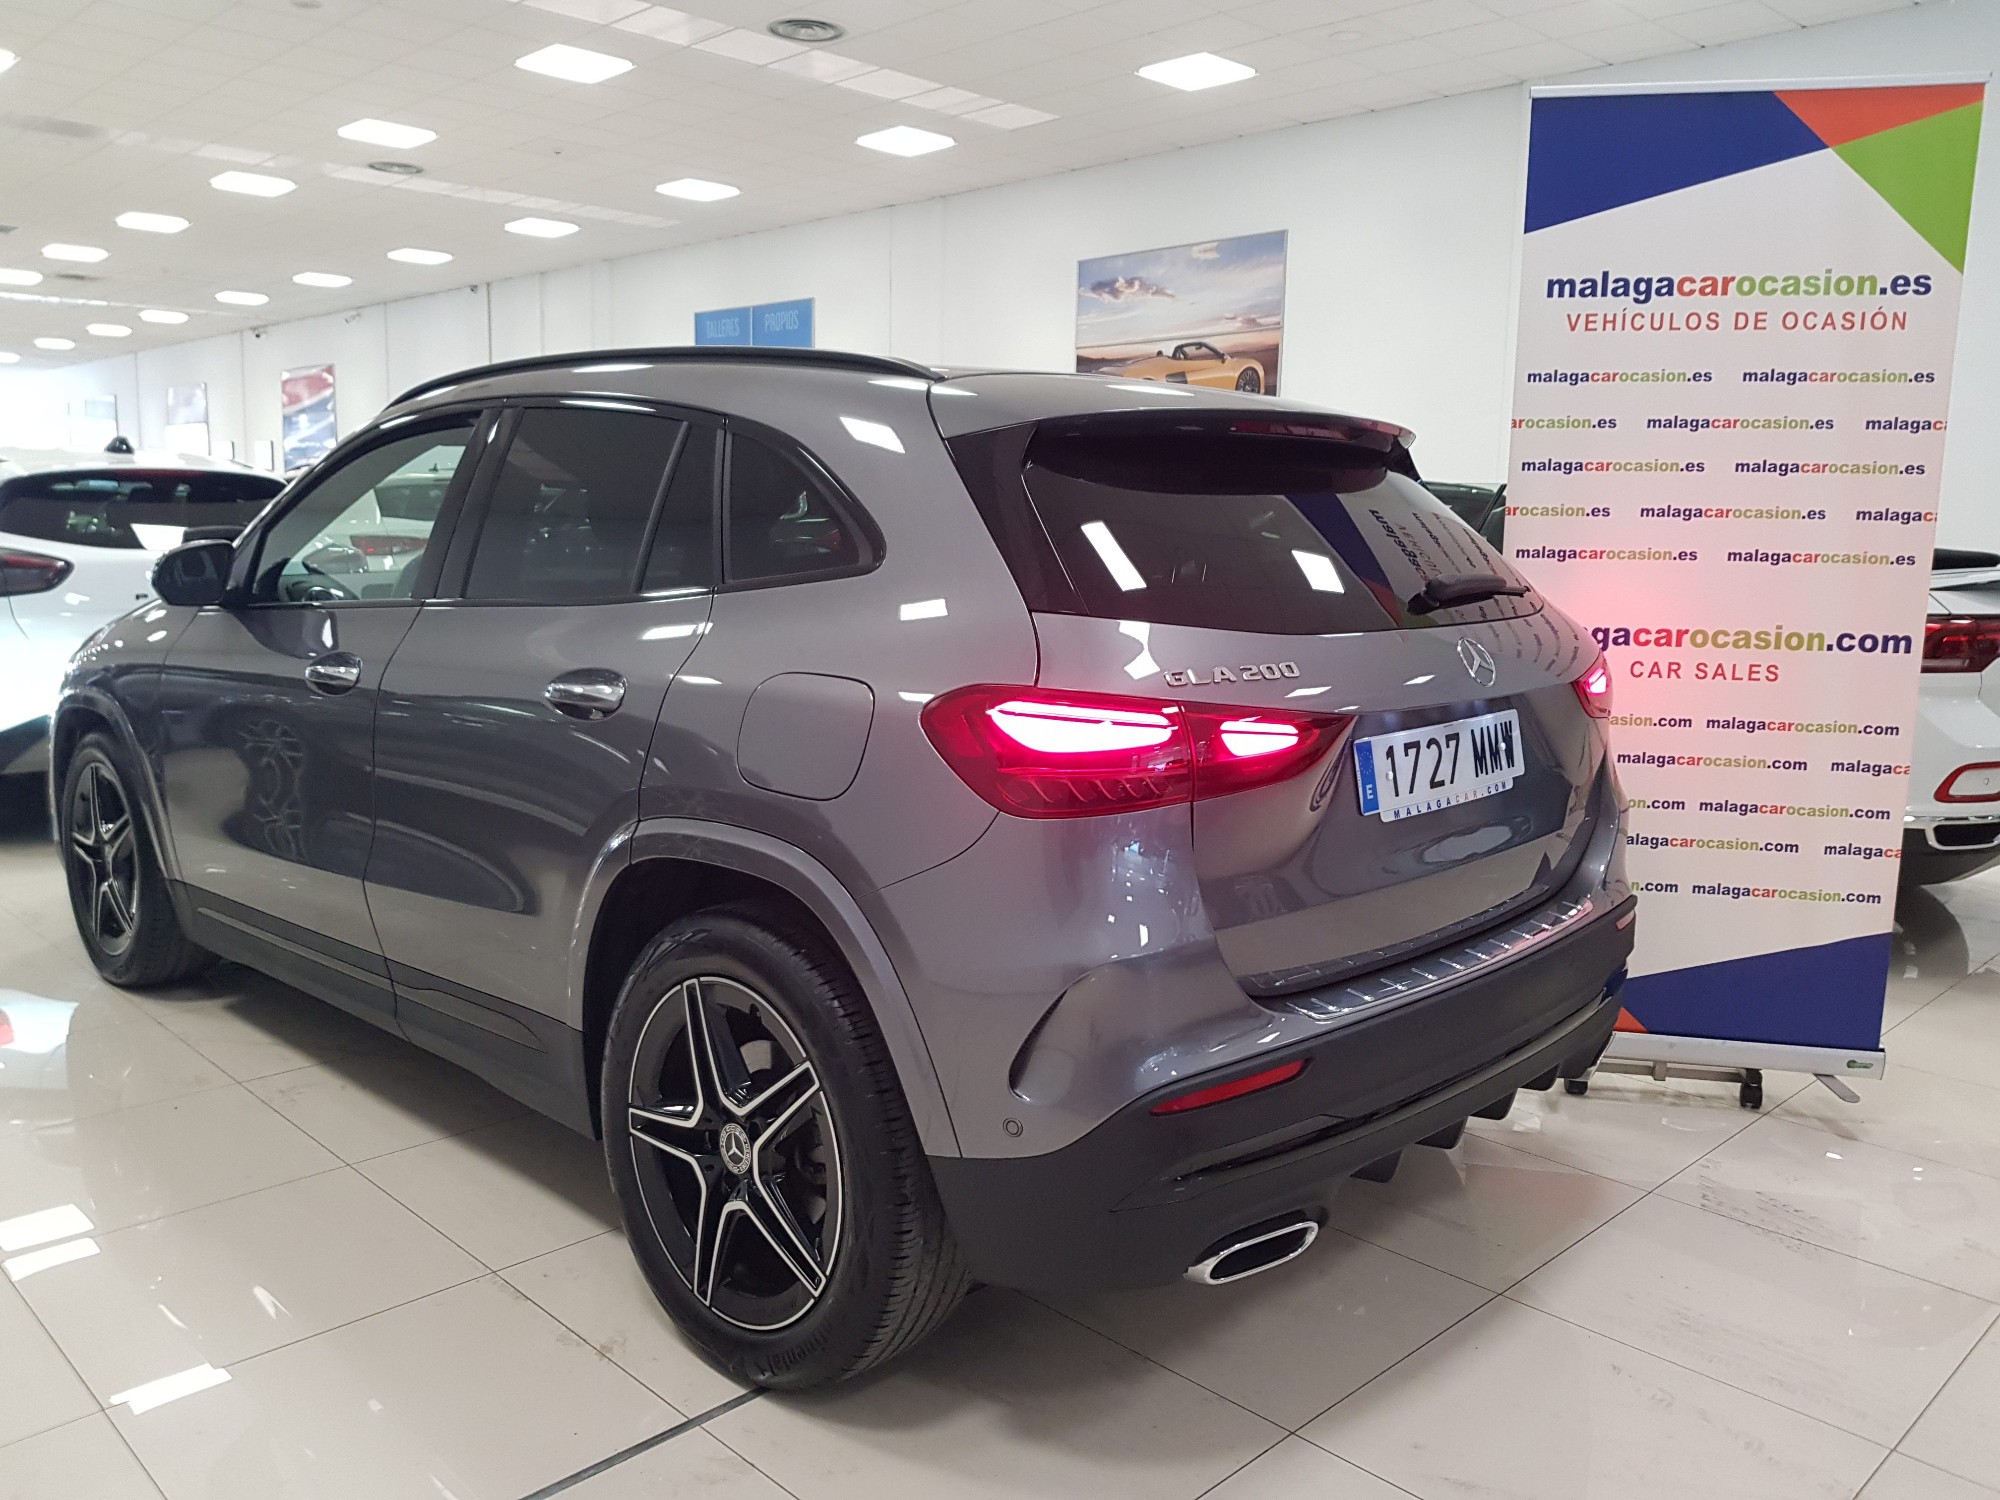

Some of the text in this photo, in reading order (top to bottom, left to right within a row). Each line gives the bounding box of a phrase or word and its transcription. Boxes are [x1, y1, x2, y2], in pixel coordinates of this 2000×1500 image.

[1546, 268, 1932, 304] malagacarocasion.es
[706, 310, 799, 338] TALLERES PROPIOS
[1567, 307, 1907, 332] VEHÍCULOS DE OCASIÓN
[1527, 367, 1935, 385] malagacarocasion.es malagacarocasion.es
[1647, 415, 1834, 432] malagacarocasion.es
[1521, 457, 1925, 476] malagacarocasion.es malagacarocasion.es
[1640, 504, 1826, 521] malagacarocasion.es
[1856, 507, 1937, 524] malagac
[1515, 545, 1916, 567] malagacarocasion.es malagacarocasion.es
[1586, 624, 1912, 654] gacarocasion.com
[1164, 662, 1300, 686] GLA 200
[1630, 660, 1780, 682] CAR SALES
[1706, 716, 1899, 736] malagacarocasion.com
[1386, 720, 1515, 797] 1727 MMW
[1617, 751, 1807, 772] malagacarocasion.com
[1366, 784, 1373, 800] E
[1699, 799, 1890, 820] malagacarocasion.com
[1692, 881, 1881, 904] malagacarocasion.com
